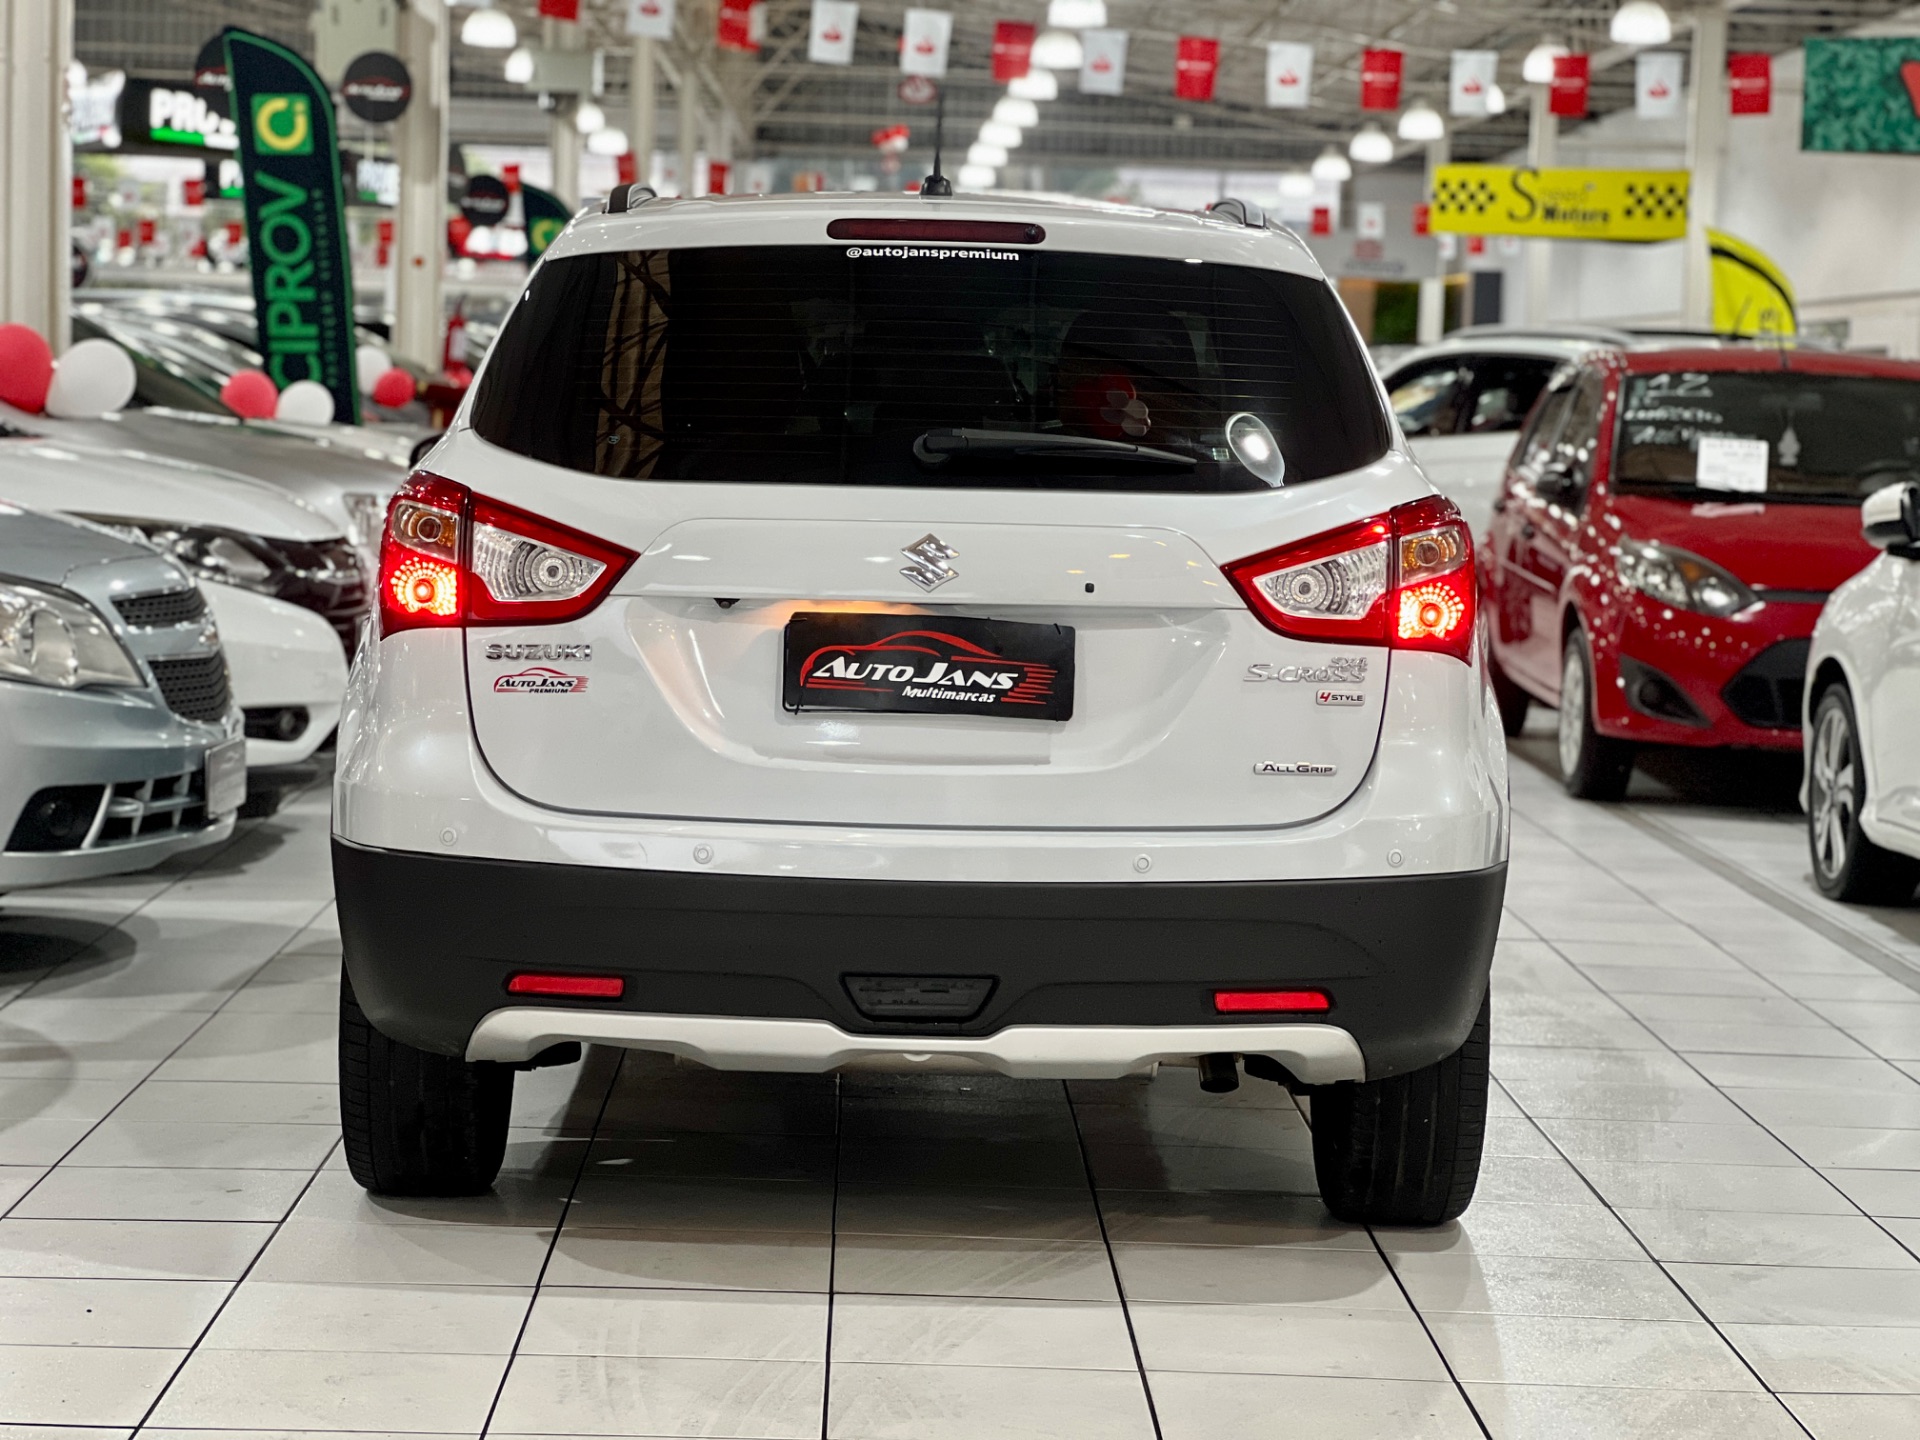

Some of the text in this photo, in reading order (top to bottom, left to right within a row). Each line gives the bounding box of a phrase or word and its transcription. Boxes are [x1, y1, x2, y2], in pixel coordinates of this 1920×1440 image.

[846, 246, 1020, 261] @autojanspremium
[485, 643, 592, 661] SUZUKI
[902, 685, 996, 703] Multimarcas
